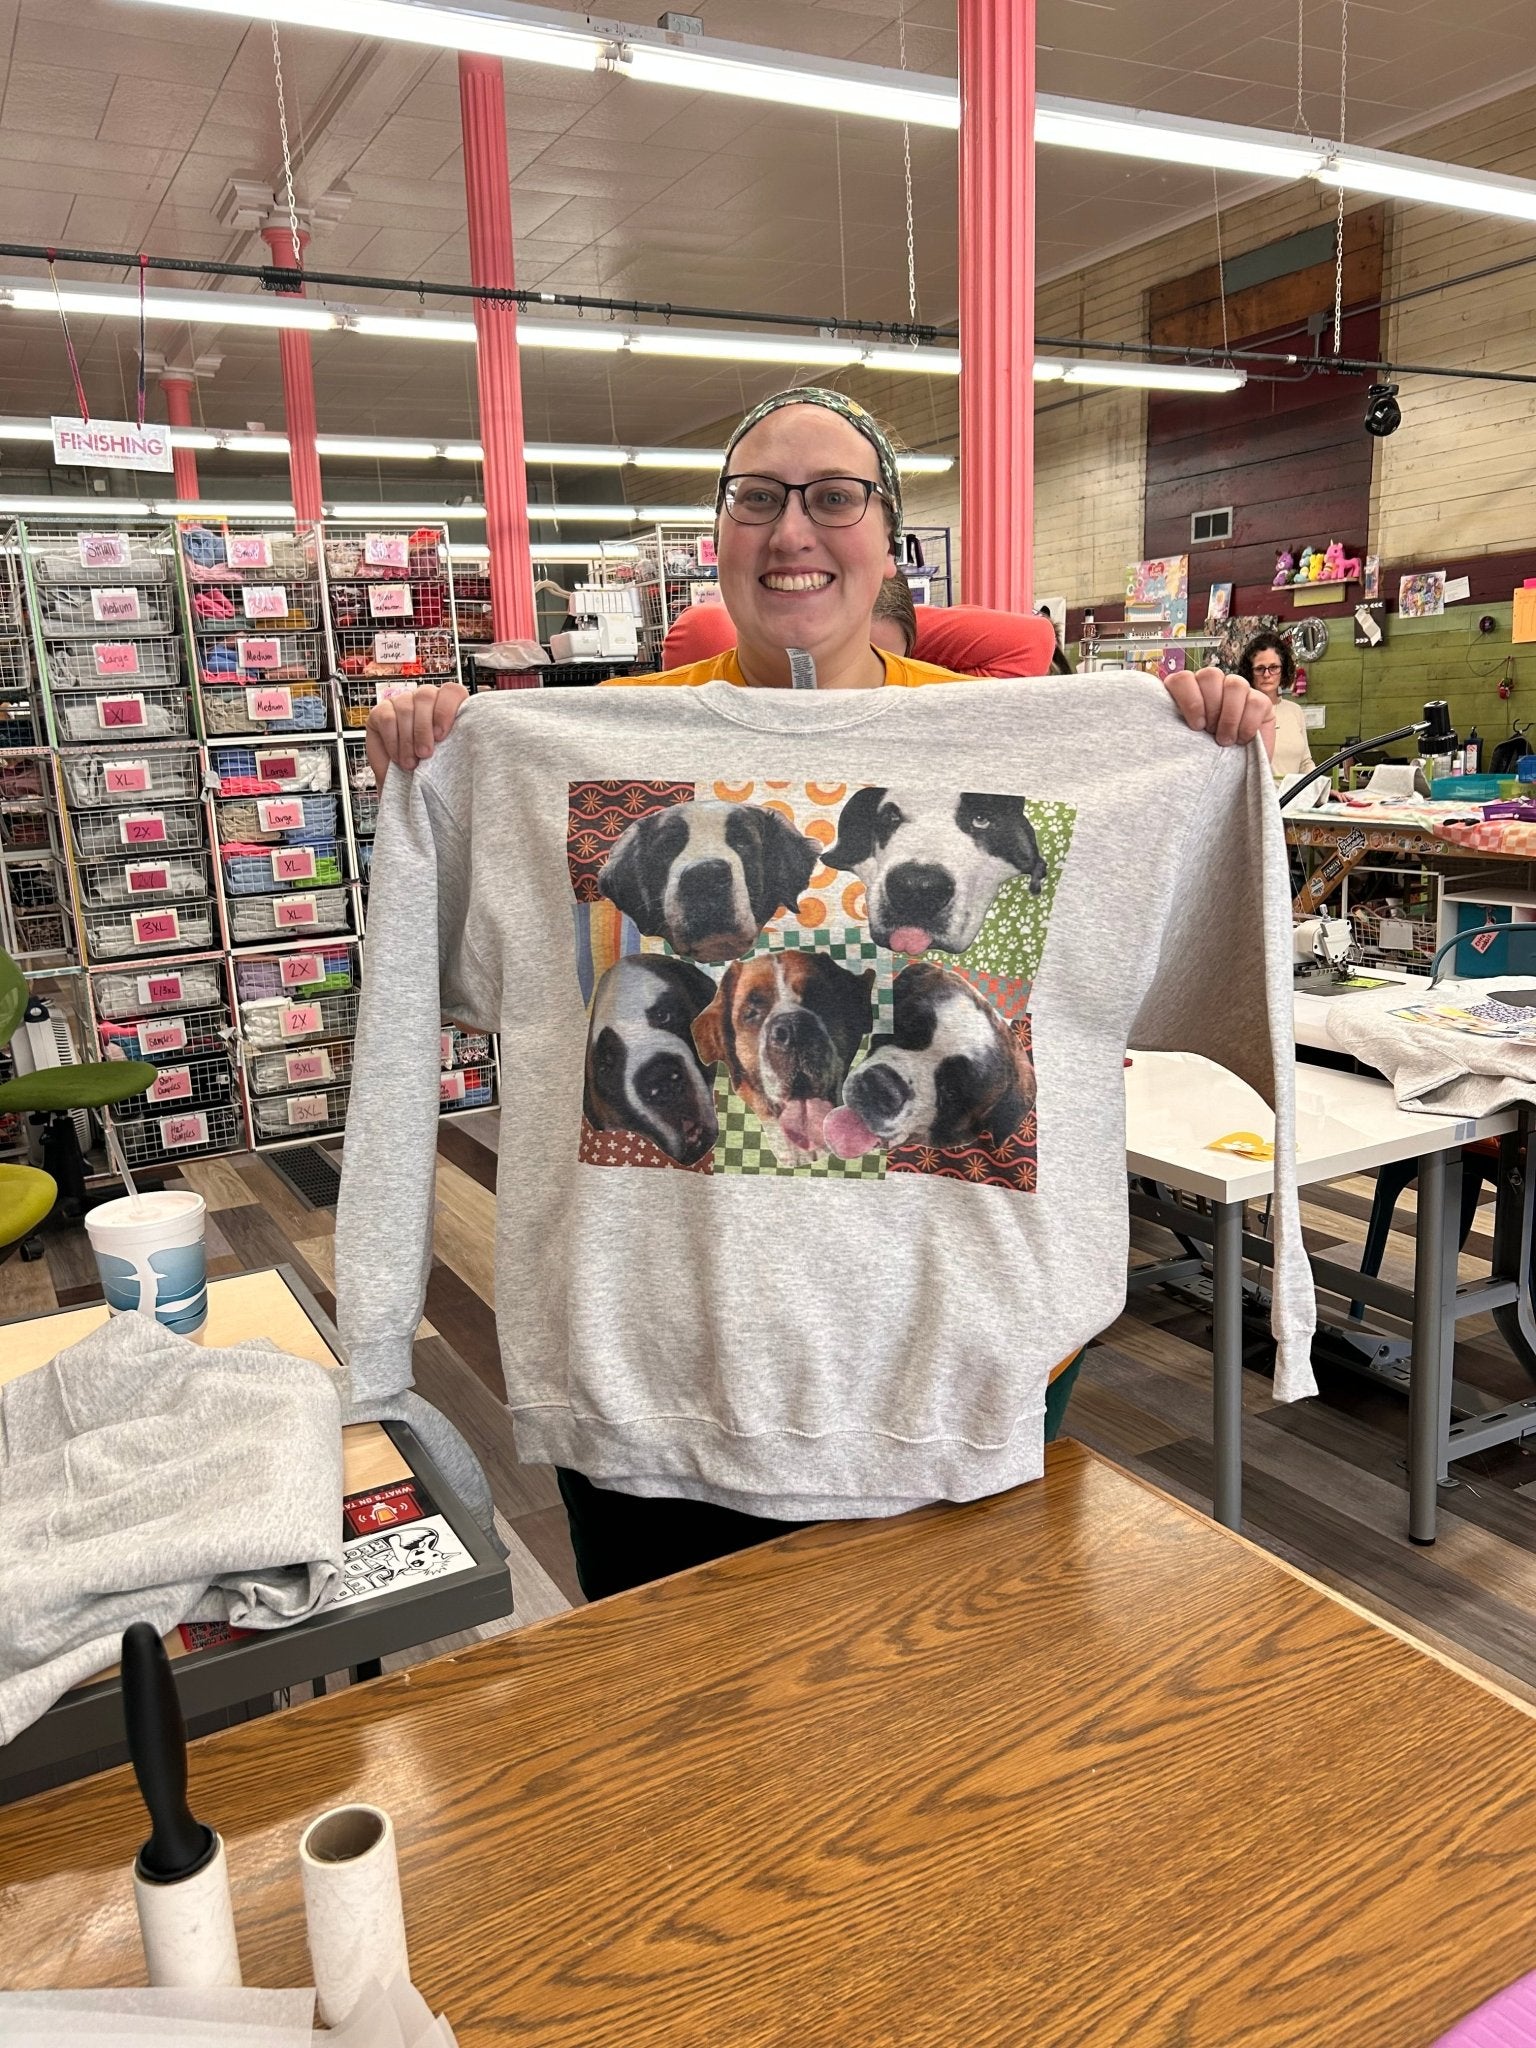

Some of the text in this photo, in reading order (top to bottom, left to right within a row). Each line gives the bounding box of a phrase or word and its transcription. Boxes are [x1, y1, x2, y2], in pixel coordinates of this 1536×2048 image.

[60, 432, 163, 455] FINISHING
[86, 543, 116, 558] Small
[102, 602, 133, 615] Medium
[246, 649, 273, 661] Medium
[257, 700, 284, 712] Medium
[110, 707, 131, 724] XL
[264, 764, 288, 778] Large
[115, 773, 134, 787] XL
[268, 811, 292, 825] Large
[133, 826, 151, 839] 2X
[284, 860, 301, 872] XL
[286, 909, 303, 921] XL
[142, 921, 167, 935] 3XL
[288, 962, 310, 978] 2X
[291, 1013, 307, 1029] 2X
[294, 1062, 315, 1076] 3XL
[296, 1104, 323, 1120] 3XL
[374, 1486, 412, 1501] WHAT'S
[358, 1497, 373, 1506] ON
